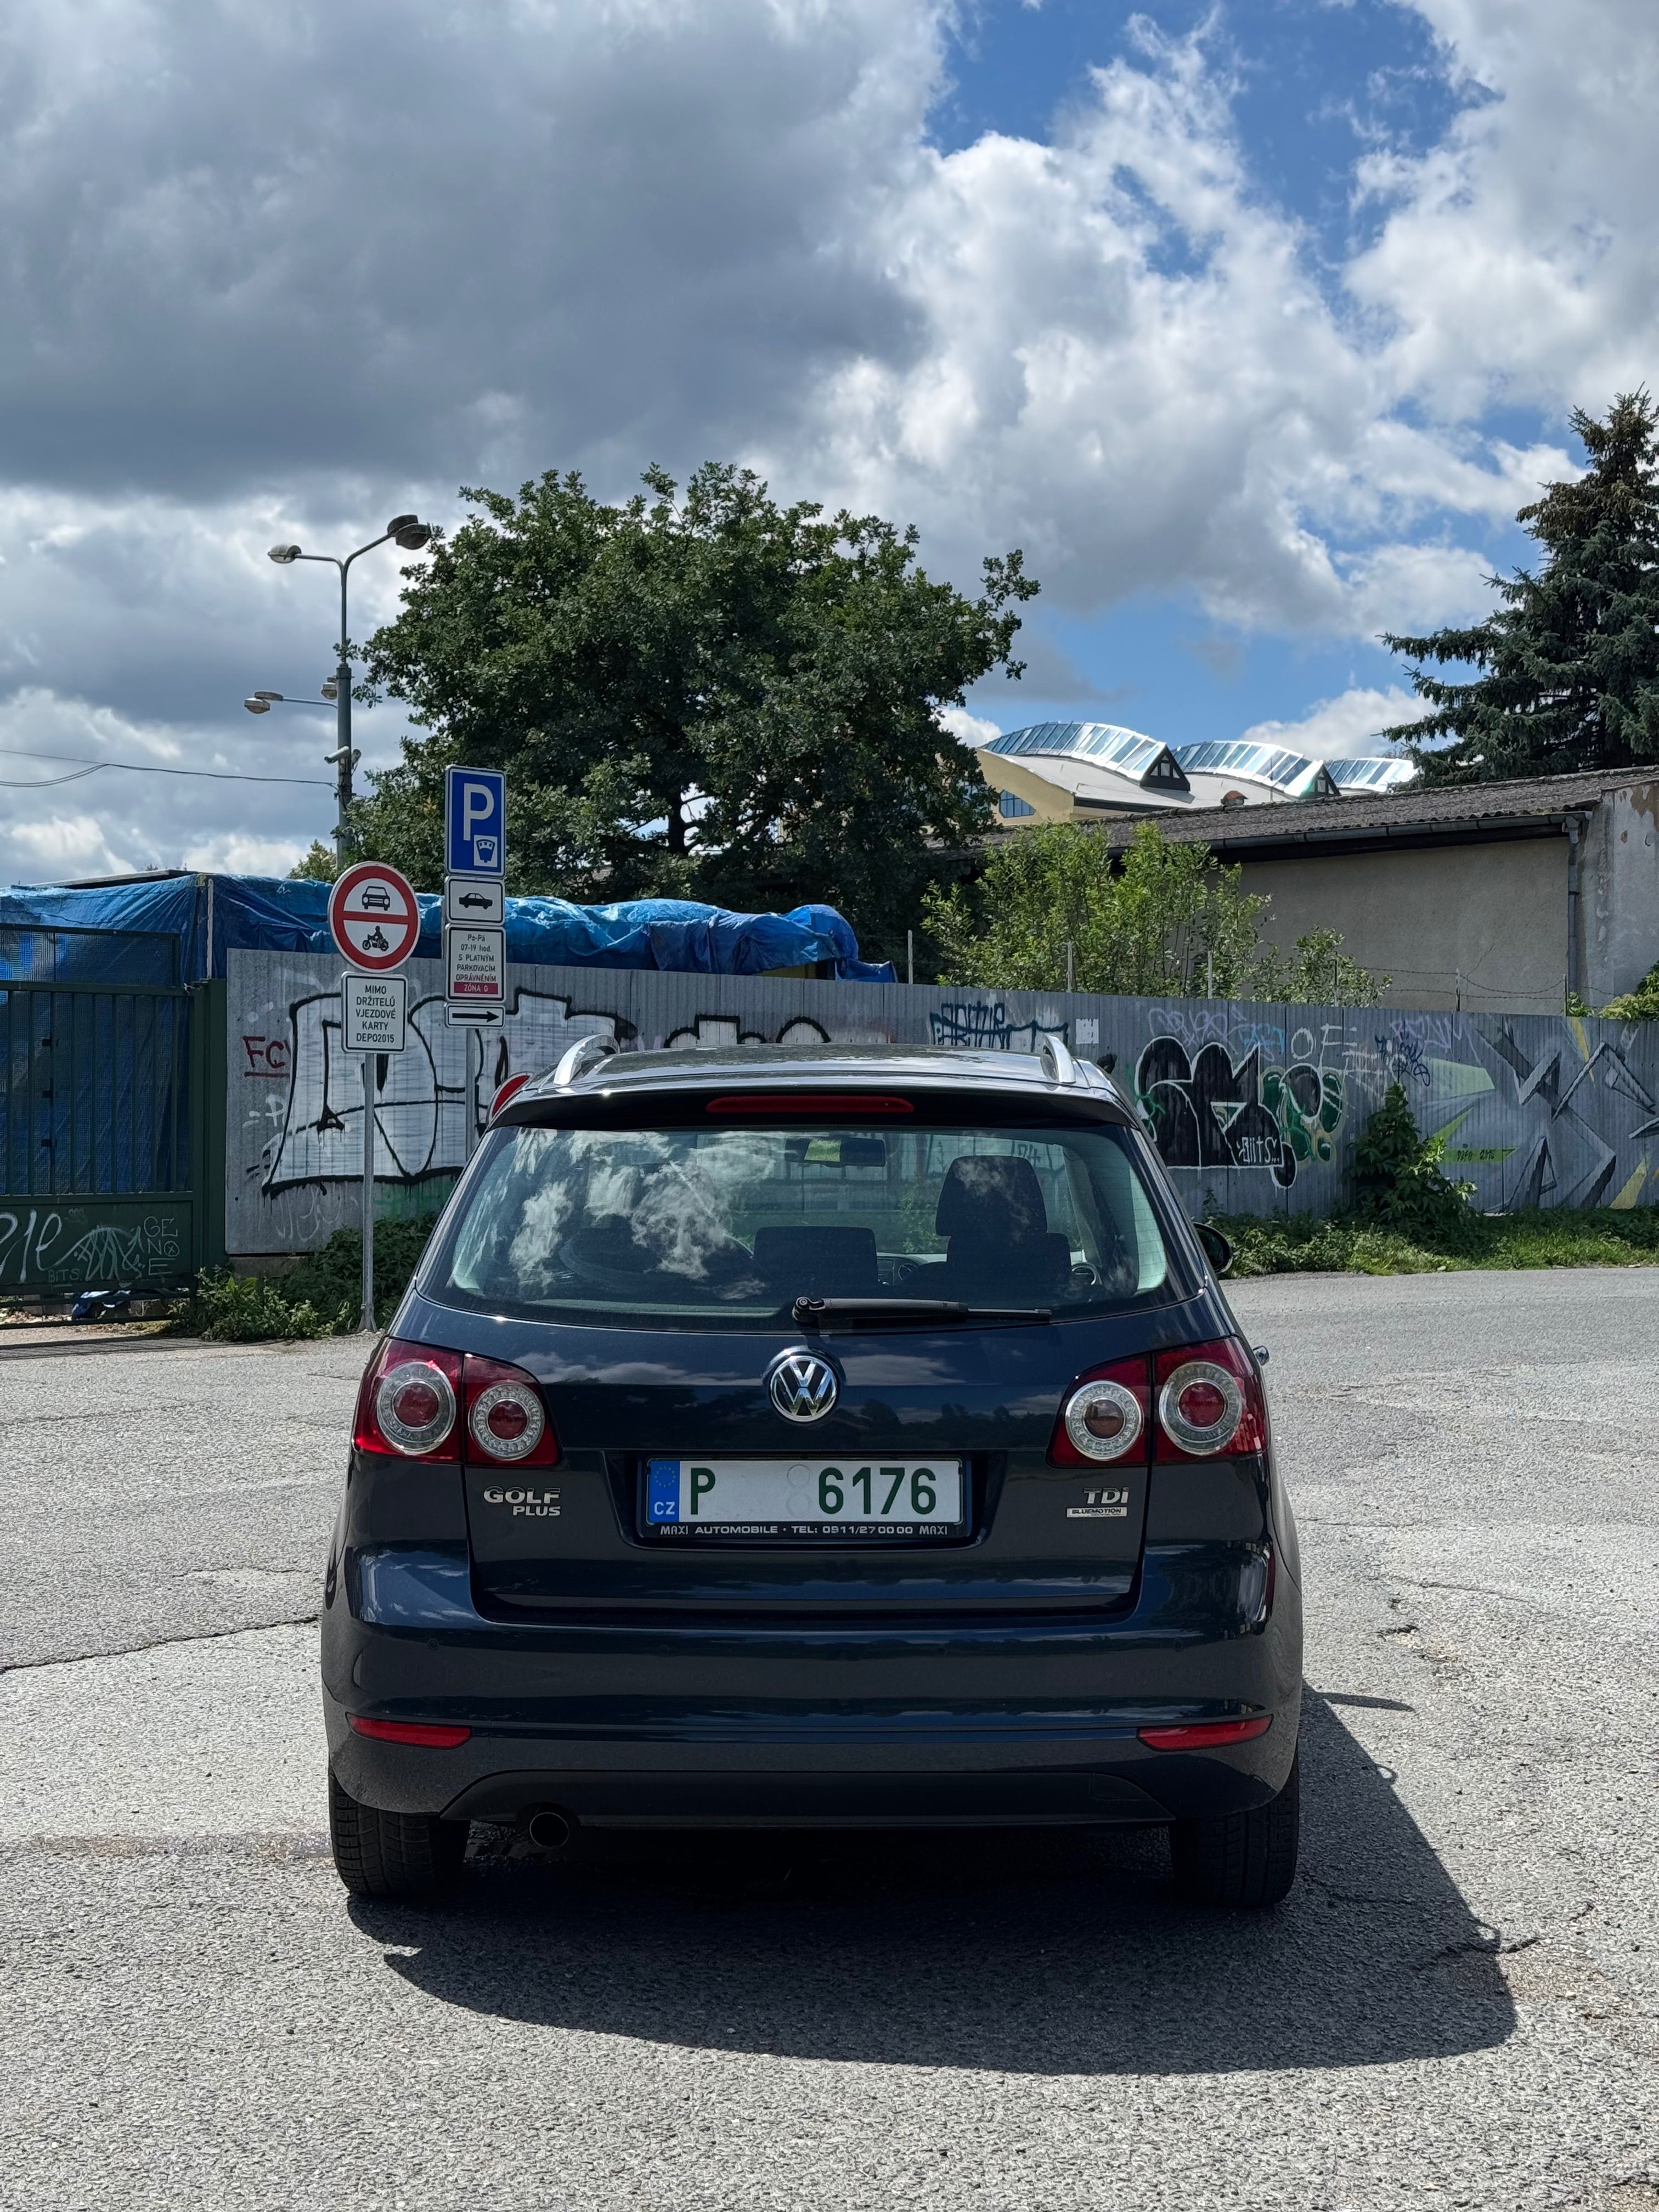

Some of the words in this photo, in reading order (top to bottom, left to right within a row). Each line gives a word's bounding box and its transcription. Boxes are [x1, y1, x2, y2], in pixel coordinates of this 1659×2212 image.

[463, 782, 494, 841] P
[467, 934, 486, 942] Po-Pá
[465, 953, 494, 962] PLATNÝM
[456, 963, 496, 972] PARKOVACÍM
[456, 973, 496, 982] OPRÁVNĚNÍM
[365, 984, 387, 995] MIMO
[464, 983, 481, 992] ZÓNA
[484, 984, 489, 992] G
[356, 995, 396, 1007] DRŽITELŮ
[356, 1008, 396, 1019] VJEZDOVÉ
[362, 1020, 388, 1031] KARTY
[356, 1032, 395, 1043] DEPO2015
[483, 1486, 561, 1504] GOLF
[654, 1501, 675, 1515] CZ
[691, 1467, 716, 1515] P
[819, 1466, 936, 1515] 6176
[512, 1505, 561, 1516] PLUS
[660, 1525, 689, 1535] MAXI
[695, 1525, 778, 1534] AUTOMOBILE
[791, 1525, 818, 1534] TEL:
[918, 1525, 948, 1535] MAXI
